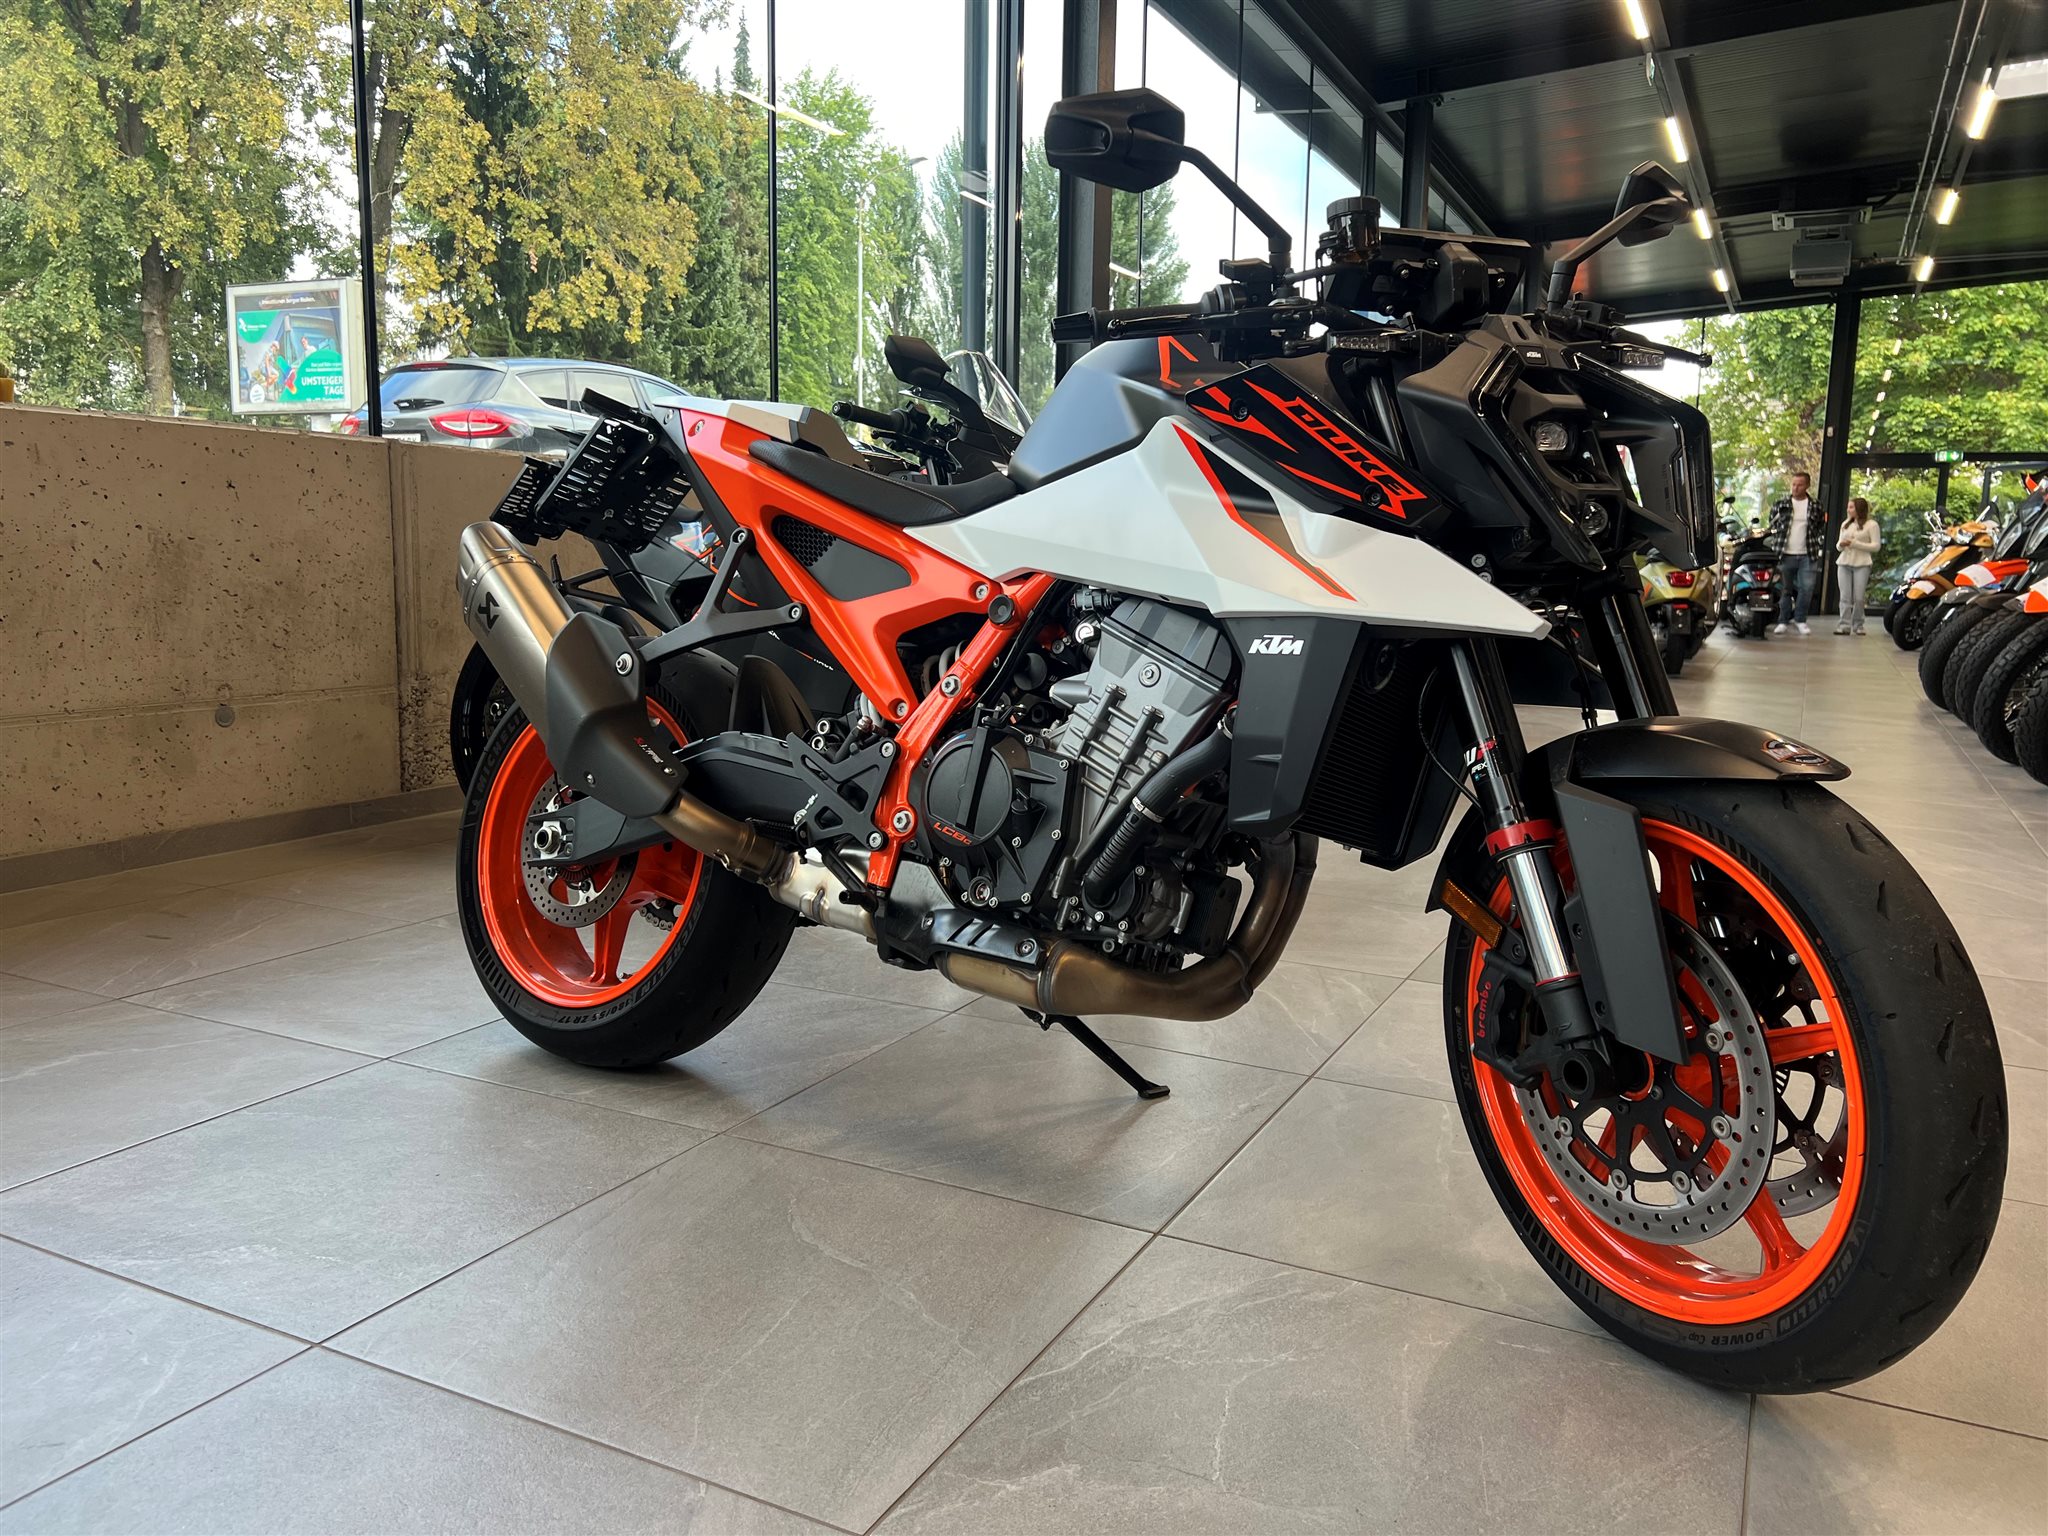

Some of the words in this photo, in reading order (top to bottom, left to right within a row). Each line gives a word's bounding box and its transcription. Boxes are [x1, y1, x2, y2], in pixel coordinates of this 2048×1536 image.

[301, 376, 343, 386] UMSTEIGER
[324, 386, 344, 395] TAGE
[1288, 404, 1415, 497] DUKE
[1248, 634, 1304, 655] KTM
[1476, 981, 1492, 1038] brembo
[557, 1015, 572, 1024] 17
[574, 1015, 589, 1024] ZR
[1778, 1251, 1853, 1335] MICHELIN
[1711, 1329, 1764, 1345] POWER
